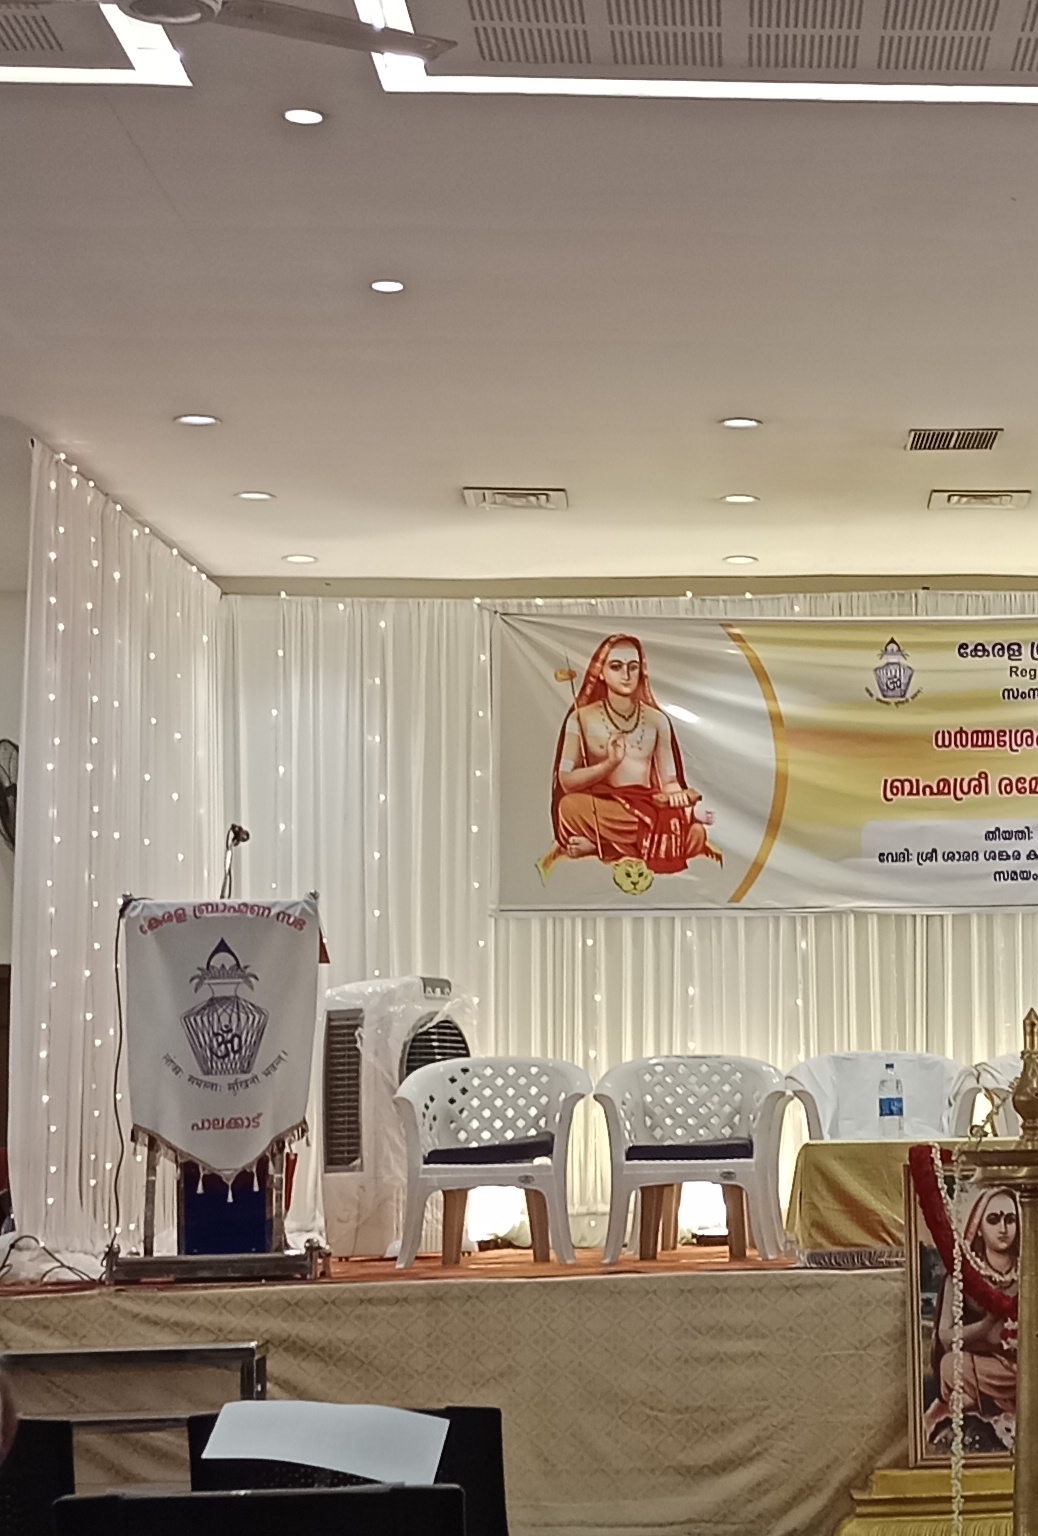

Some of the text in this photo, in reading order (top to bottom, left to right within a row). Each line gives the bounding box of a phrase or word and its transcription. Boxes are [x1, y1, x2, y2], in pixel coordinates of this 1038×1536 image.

[957, 641, 1023, 662] കേരള
[1009, 665, 1037, 680] Reg
[882, 770, 990, 802] ബ്രഹ്മശ്രീ
[916, 847, 938, 866] ശ്രീ
[139, 907, 187, 935] കേരള
[276, 910, 307, 932] സഭ
[191, 1112, 264, 1132] പാലക്കാട്
